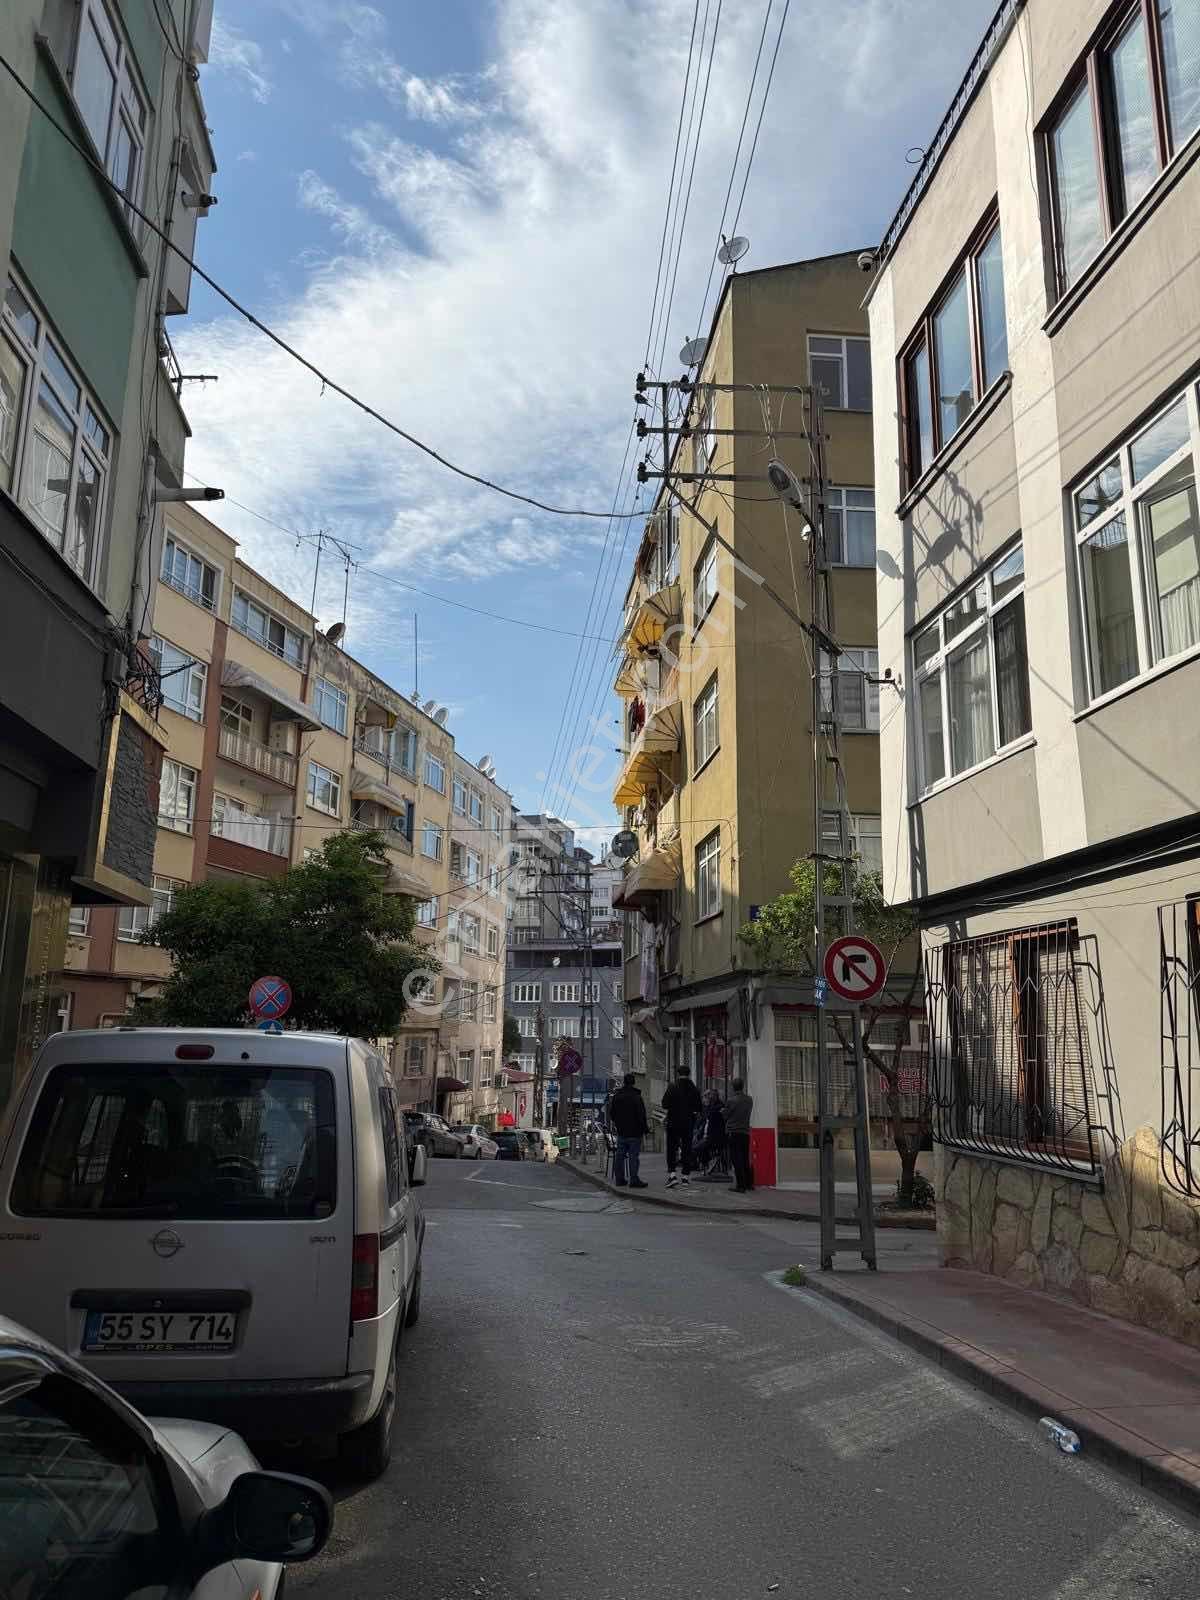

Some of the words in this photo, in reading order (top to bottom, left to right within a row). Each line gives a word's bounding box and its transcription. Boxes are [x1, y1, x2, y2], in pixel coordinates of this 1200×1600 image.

[100, 1315, 133, 1341] 55
[140, 1315, 174, 1341] SY
[188, 1315, 232, 1341] 714
